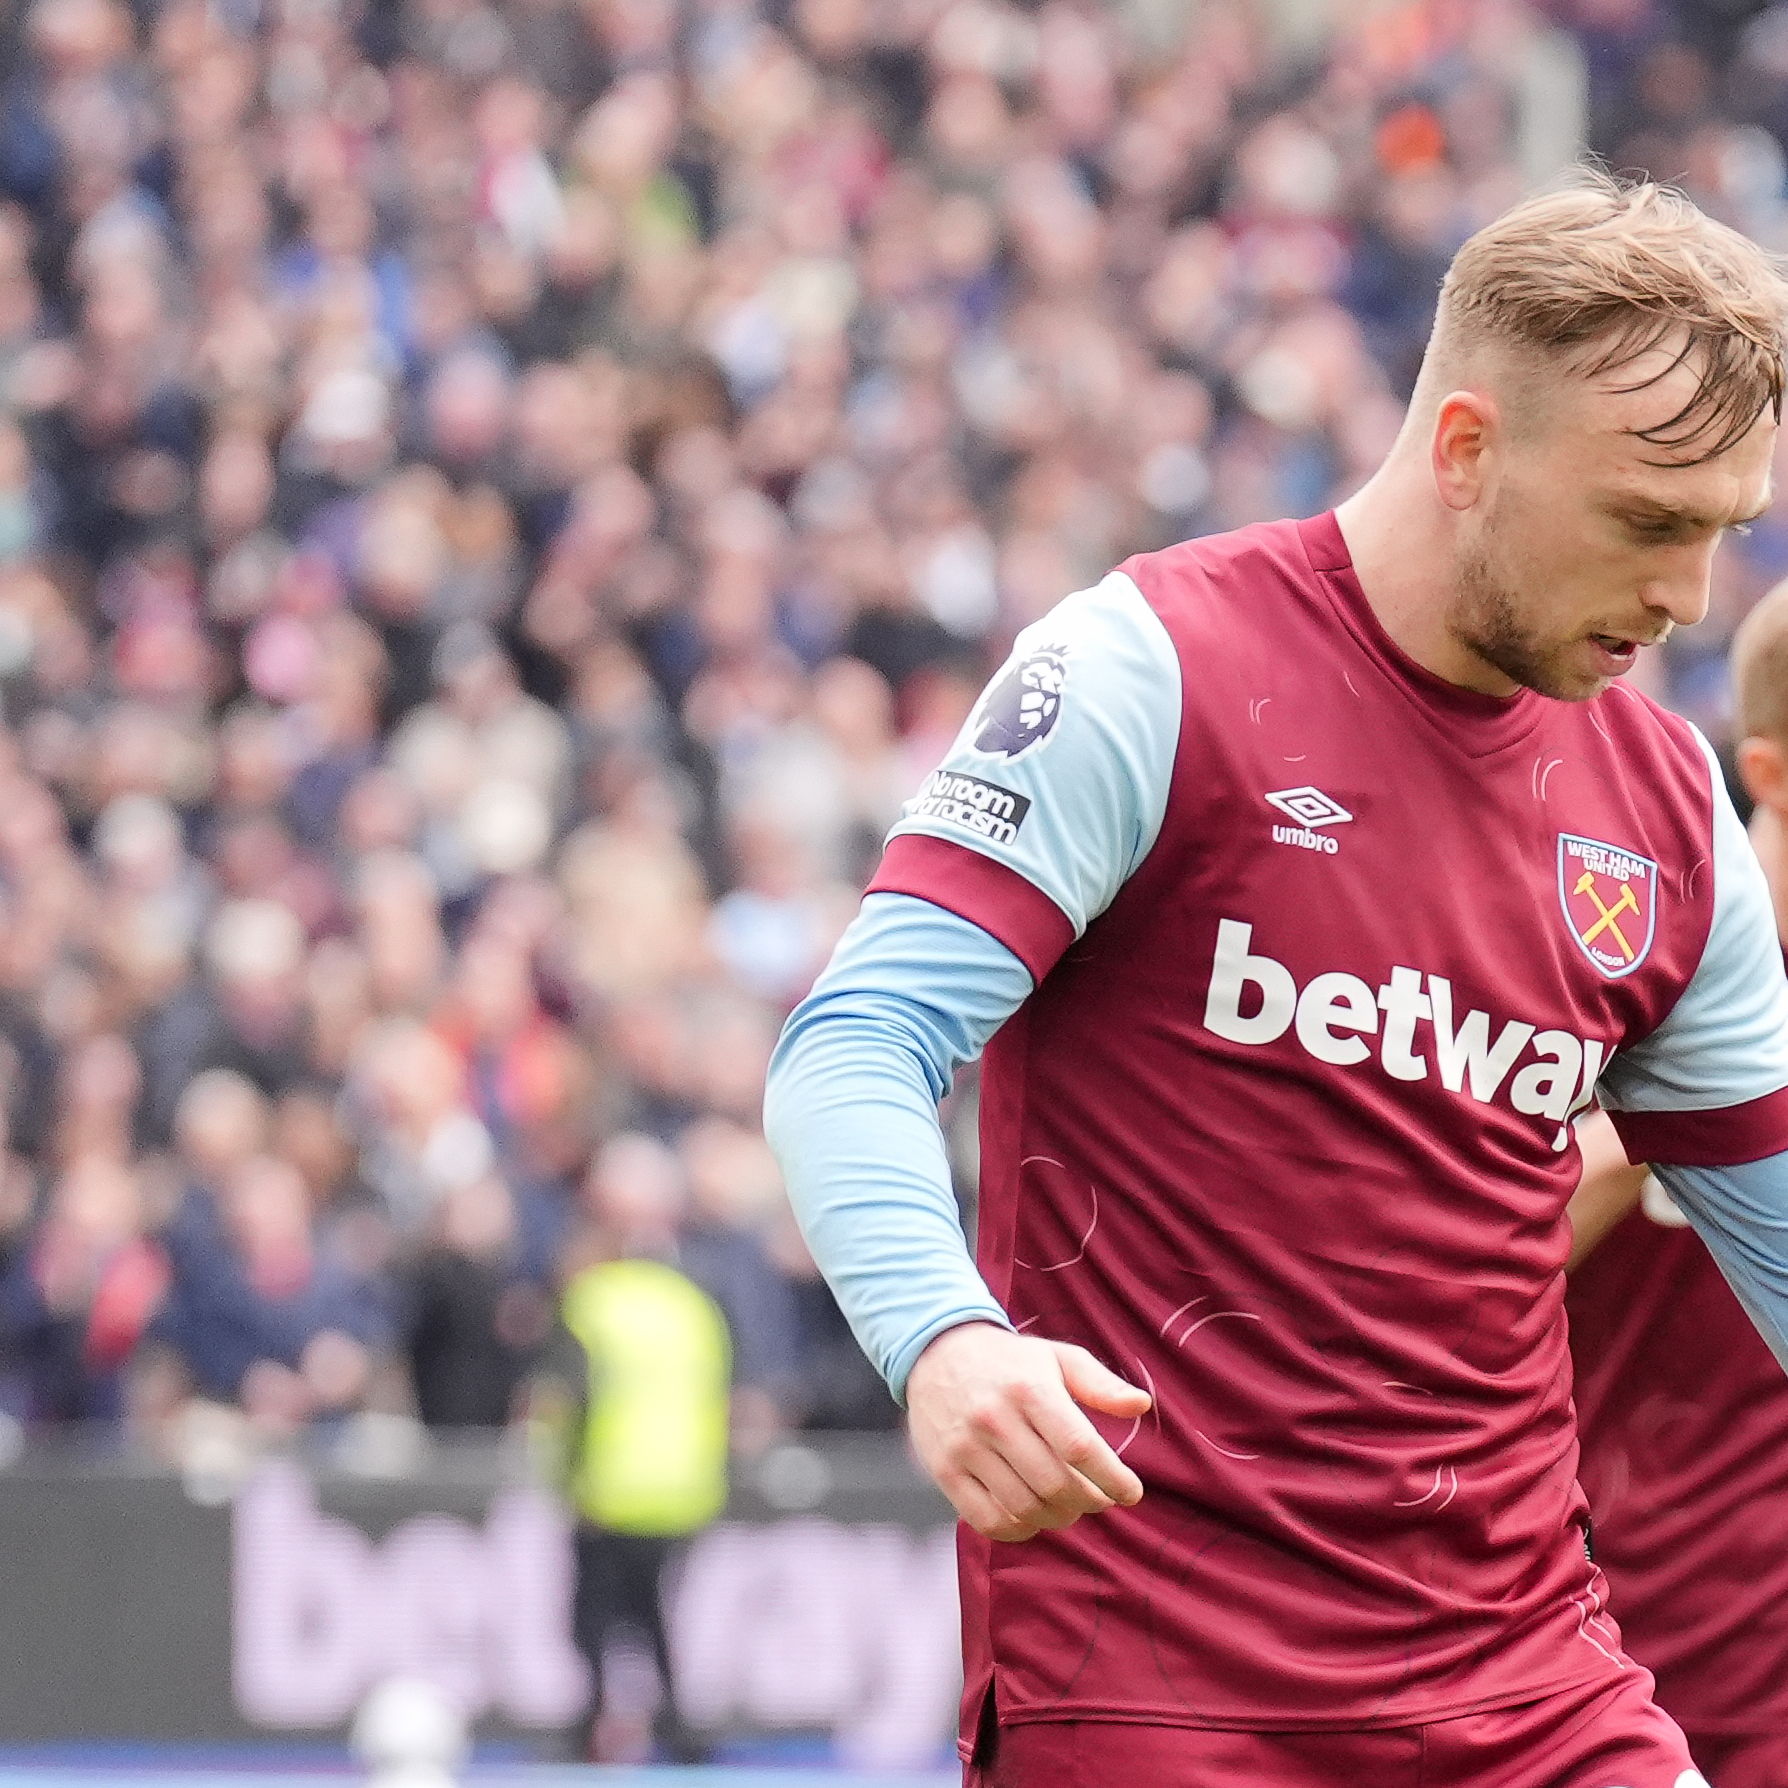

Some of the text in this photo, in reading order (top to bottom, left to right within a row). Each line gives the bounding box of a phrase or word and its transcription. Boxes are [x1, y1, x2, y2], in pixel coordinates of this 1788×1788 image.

[929, 771, 1016, 820] No room
[937, 797, 1019, 845] racism
[1272, 824, 1339, 855] umbro
[1567, 840, 1646, 878] WEST HAM
[1583, 858, 1630, 882] UNITED
[1591, 947, 1626, 967] LONDON
[1203, 917, 1618, 1153] betway
